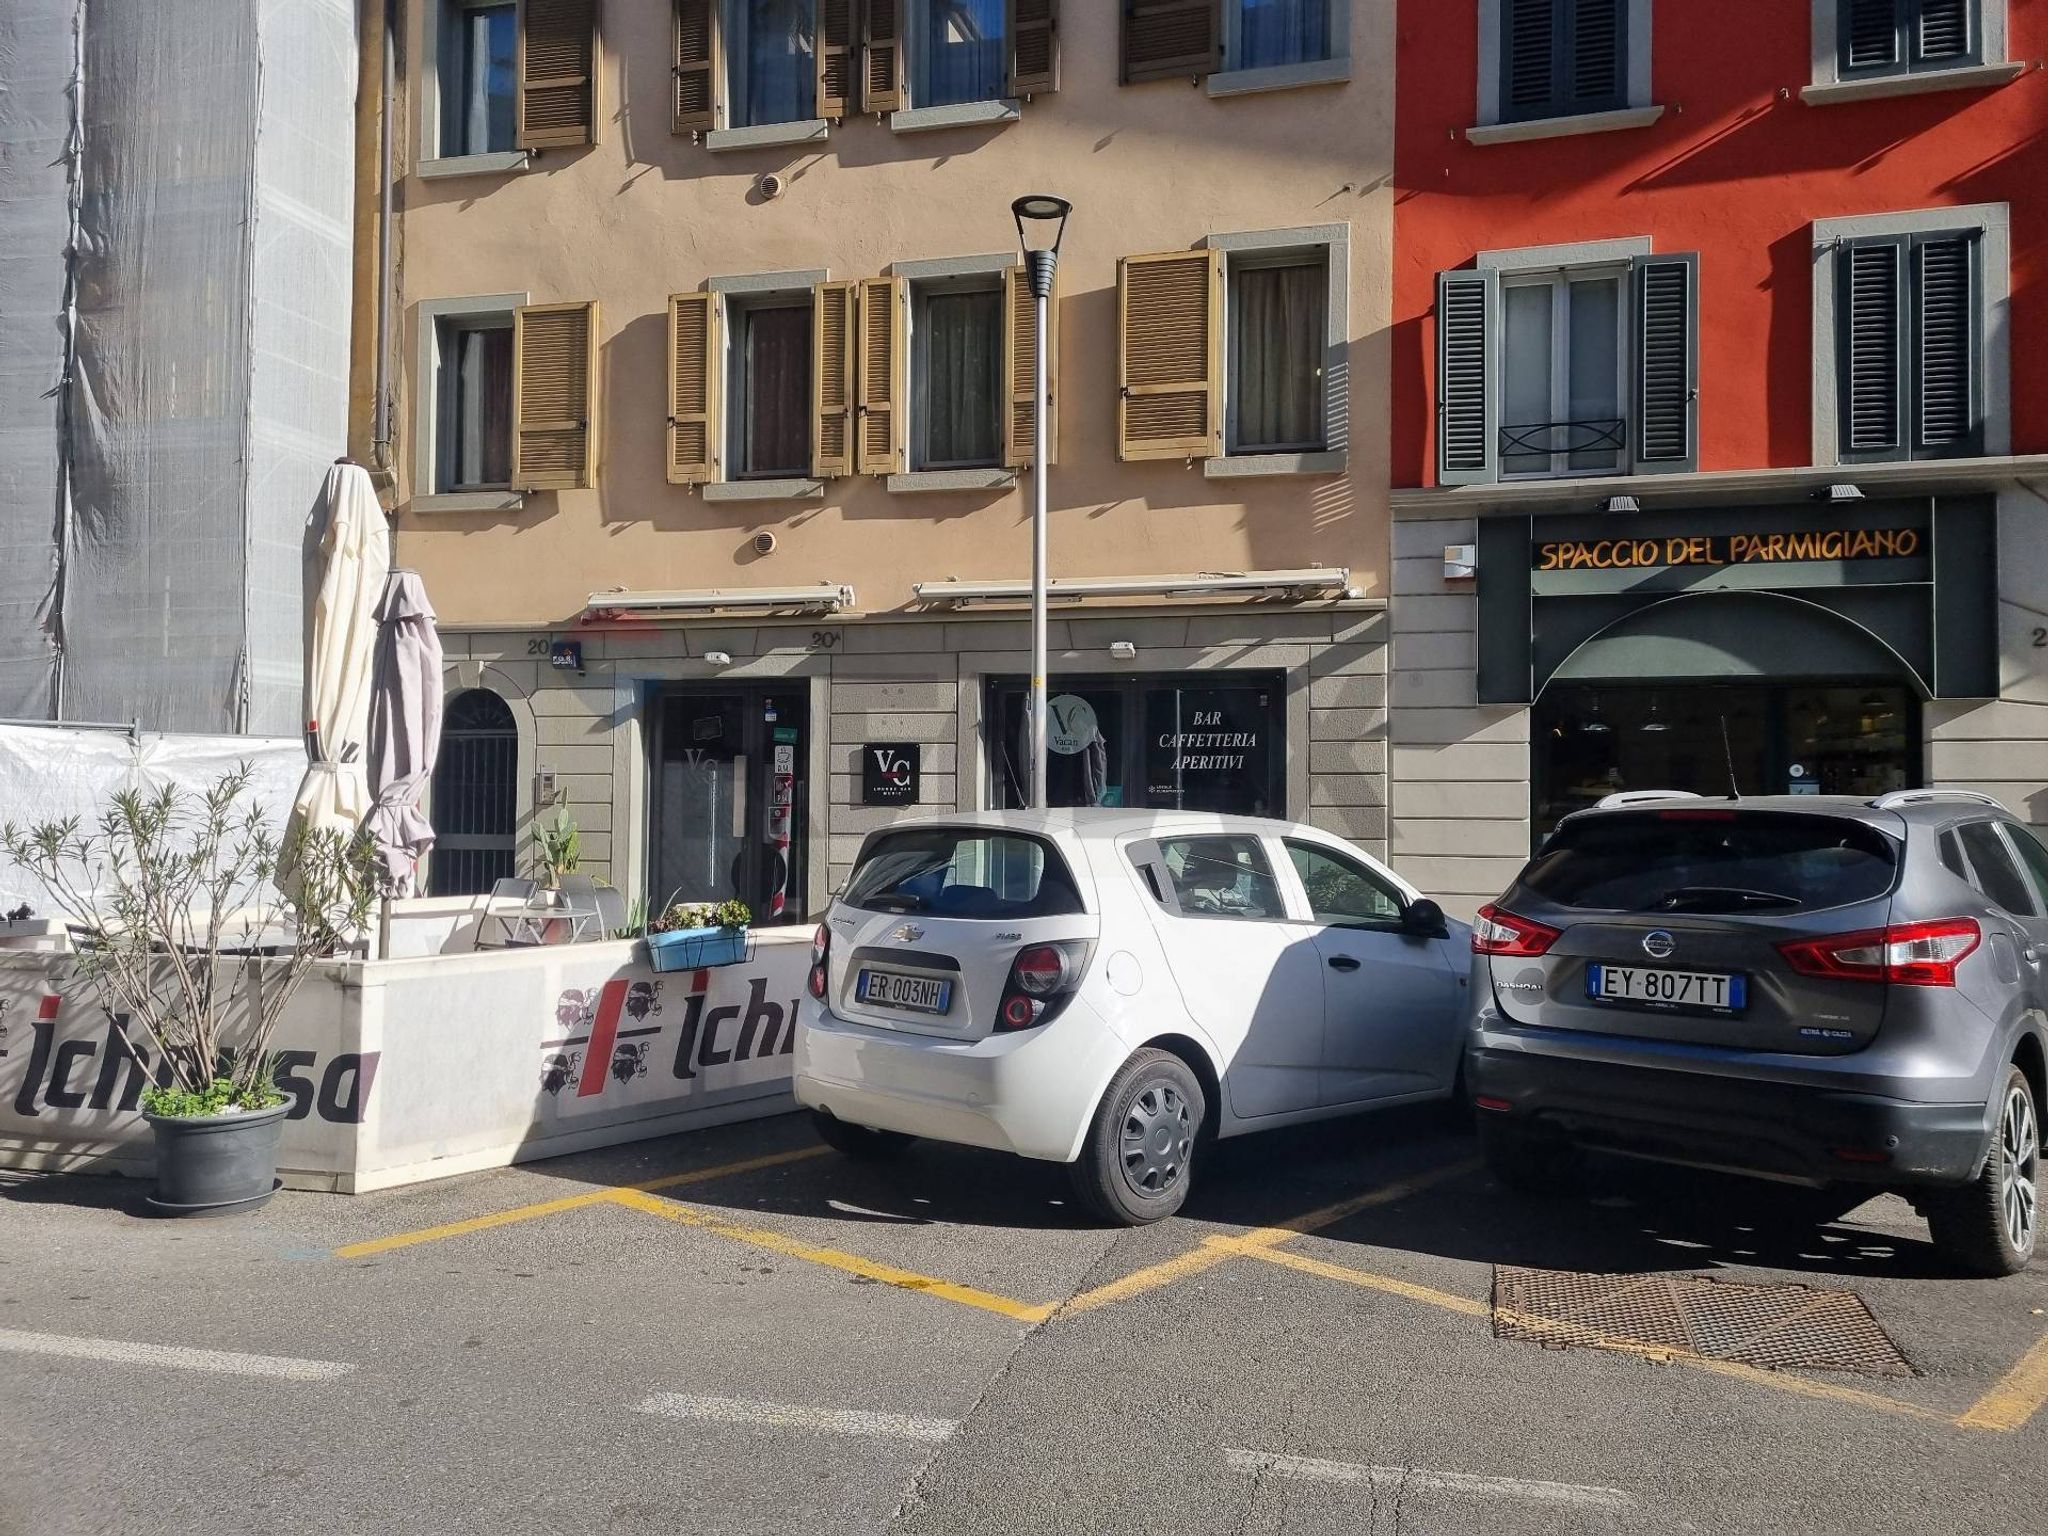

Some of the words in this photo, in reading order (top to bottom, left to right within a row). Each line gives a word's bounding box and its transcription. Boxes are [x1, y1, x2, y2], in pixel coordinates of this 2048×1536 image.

[1540, 538, 1659, 570] SPACCIO
[1666, 537, 1724, 565] DEL
[1729, 528, 1918, 562] PARMIGIANO
[527, 639, 549, 655] 20
[1193, 711, 1222, 725] BAR
[1159, 733, 1257, 748] CAFFETTERIA
[1170, 755, 1245, 770] APERITIVI
[868, 975, 889, 999] ER
[892, 978, 941, 1006] 003NH
[1604, 969, 1634, 996] EY
[1644, 972, 1726, 1004] 807TT
